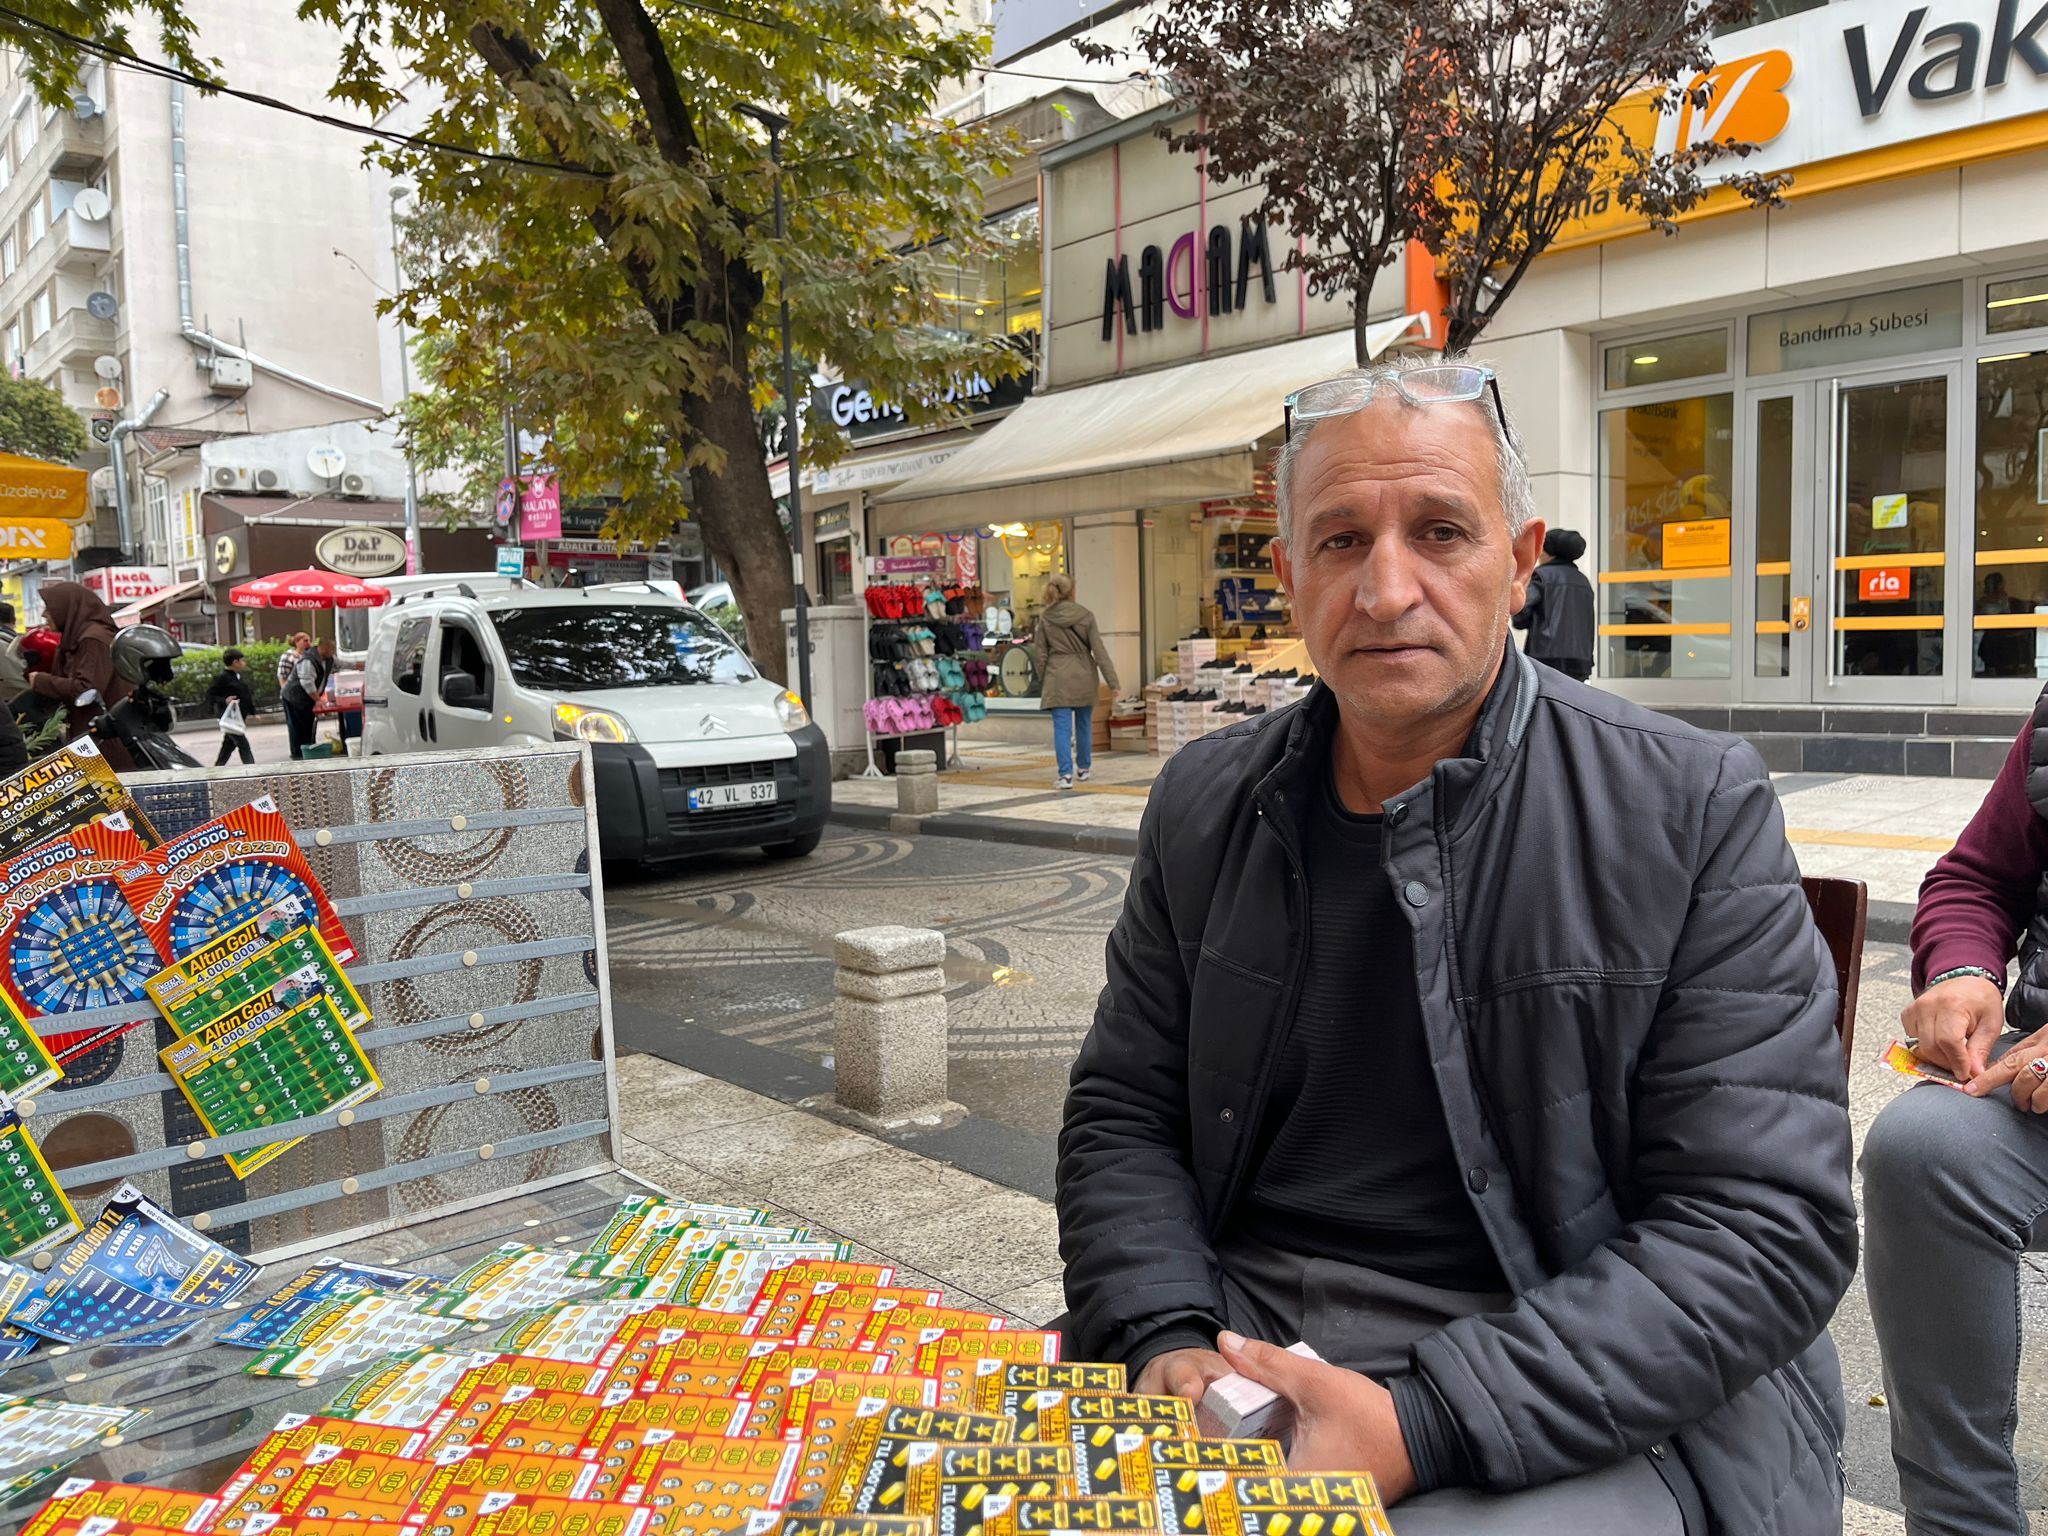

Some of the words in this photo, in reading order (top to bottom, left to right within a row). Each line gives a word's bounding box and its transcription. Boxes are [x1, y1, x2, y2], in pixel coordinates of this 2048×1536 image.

[1102, 216, 1276, 341] MADAM
[1779, 323, 1862, 347] Bandırma
[1869, 308, 1929, 337] Şubesi
[0, 483, 67, 501] üzdeyüz
[334, 551, 396, 566] perfumum
[344, 536, 382, 551] D&P
[558, 542, 593, 552] ADALET
[1869, 570, 1900, 591] ria
[285, 599, 322, 609] ALGIDA
[22, 753, 76, 794] ALTIN
[1, 774, 74, 819] 8.000.000
[23, 791, 66, 816] OYUNLAR
[697, 789, 714, 805] 42
[724, 787, 740, 803] VL
[750, 783, 774, 800] 837
[0, 846, 78, 894] 8.000.000
[80, 848, 96, 856] TL
[156, 829, 230, 876] 8.000.000
[232, 830, 247, 838] TL
[7, 868, 72, 909] Yönde
[75, 861, 127, 878] Kaza
[143, 885, 173, 921] Her
[167, 849, 226, 889] Yönde
[227, 841, 288, 858] Kazan
[285, 901, 296, 912] 50
[189, 948, 227, 976] Altın
[226, 922, 260, 952] Gol!
[196, 943, 256, 984] 4.000.000
[300, 970, 311, 981] 50
[204, 1019, 243, 1046] Altın
[241, 992, 275, 1024] Gol!
[211, 1012, 272, 1053] 4.000.000
[59, 1219, 114, 1276] 4.000.000
[102, 1208, 125, 1226] TL
[107, 1222, 136, 1257] ELMAS
[125, 1234, 147, 1257] YEDİ
[174, 1277, 196, 1301] BONUS
[193, 1251, 221, 1282] OYUNLAR
[251, 1437, 287, 1474] 2.000.000
[832, 1461, 864, 1513] SÜPER
[856, 1416, 881, 1465] ALTIN
[283, 1471, 319, 1514] 2.000.000
[349, 1465, 375, 1489] ÖDÜL
[379, 1470, 407, 1494] ÖDÜL
[419, 1471, 453, 1514] 2.000.000
[483, 1463, 508, 1487] ÖDÜL
[515, 1467, 540, 1489] ÖDÜL
[547, 1470, 573, 1493] ÖDÜL
[921, 1464, 938, 1515] ALTIN
